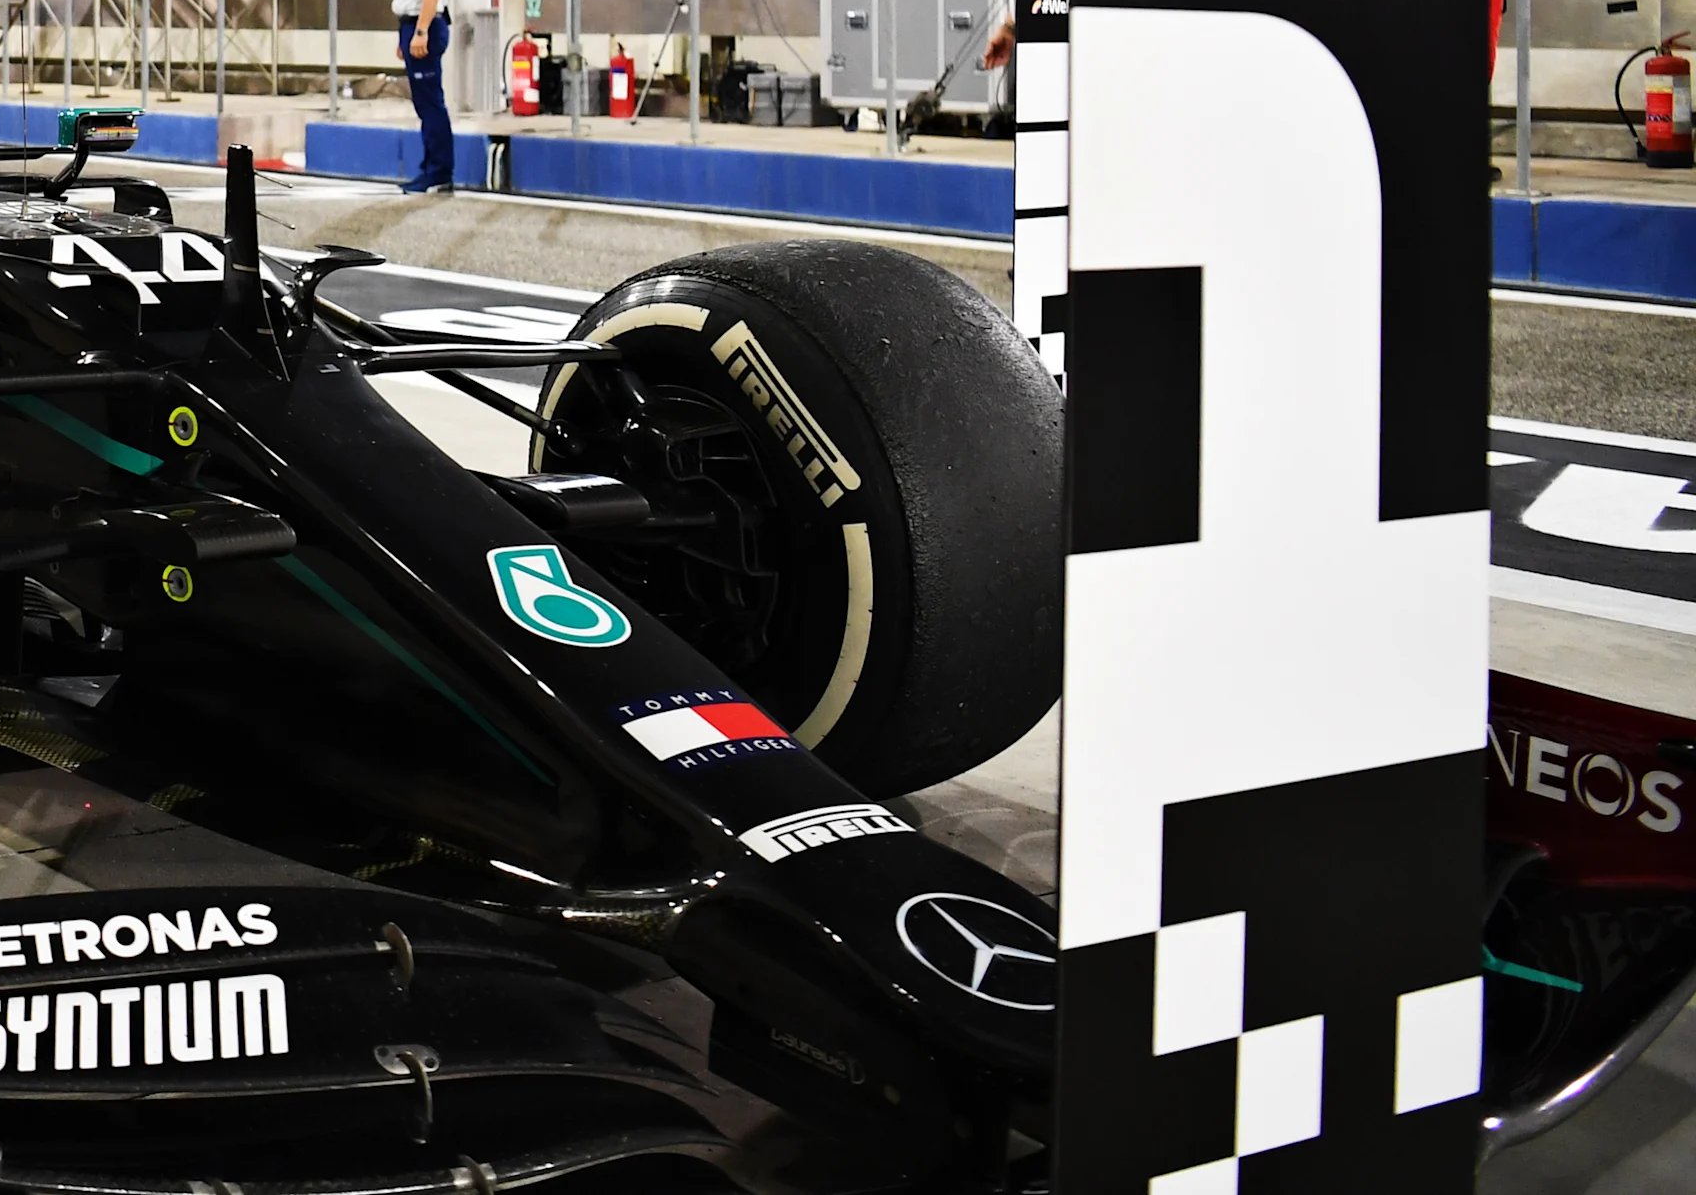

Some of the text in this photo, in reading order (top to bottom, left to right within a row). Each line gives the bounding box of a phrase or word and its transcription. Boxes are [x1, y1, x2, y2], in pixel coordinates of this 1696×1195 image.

[710, 320, 861, 508] PIRELLI
[1061, 7, 1489, 811] 1
[619, 690, 735, 717] TOMMY
[677, 739, 797, 769] HILFIGER
[1488, 723, 1684, 833] NEOS
[738, 803, 917, 863] PIRELLI
